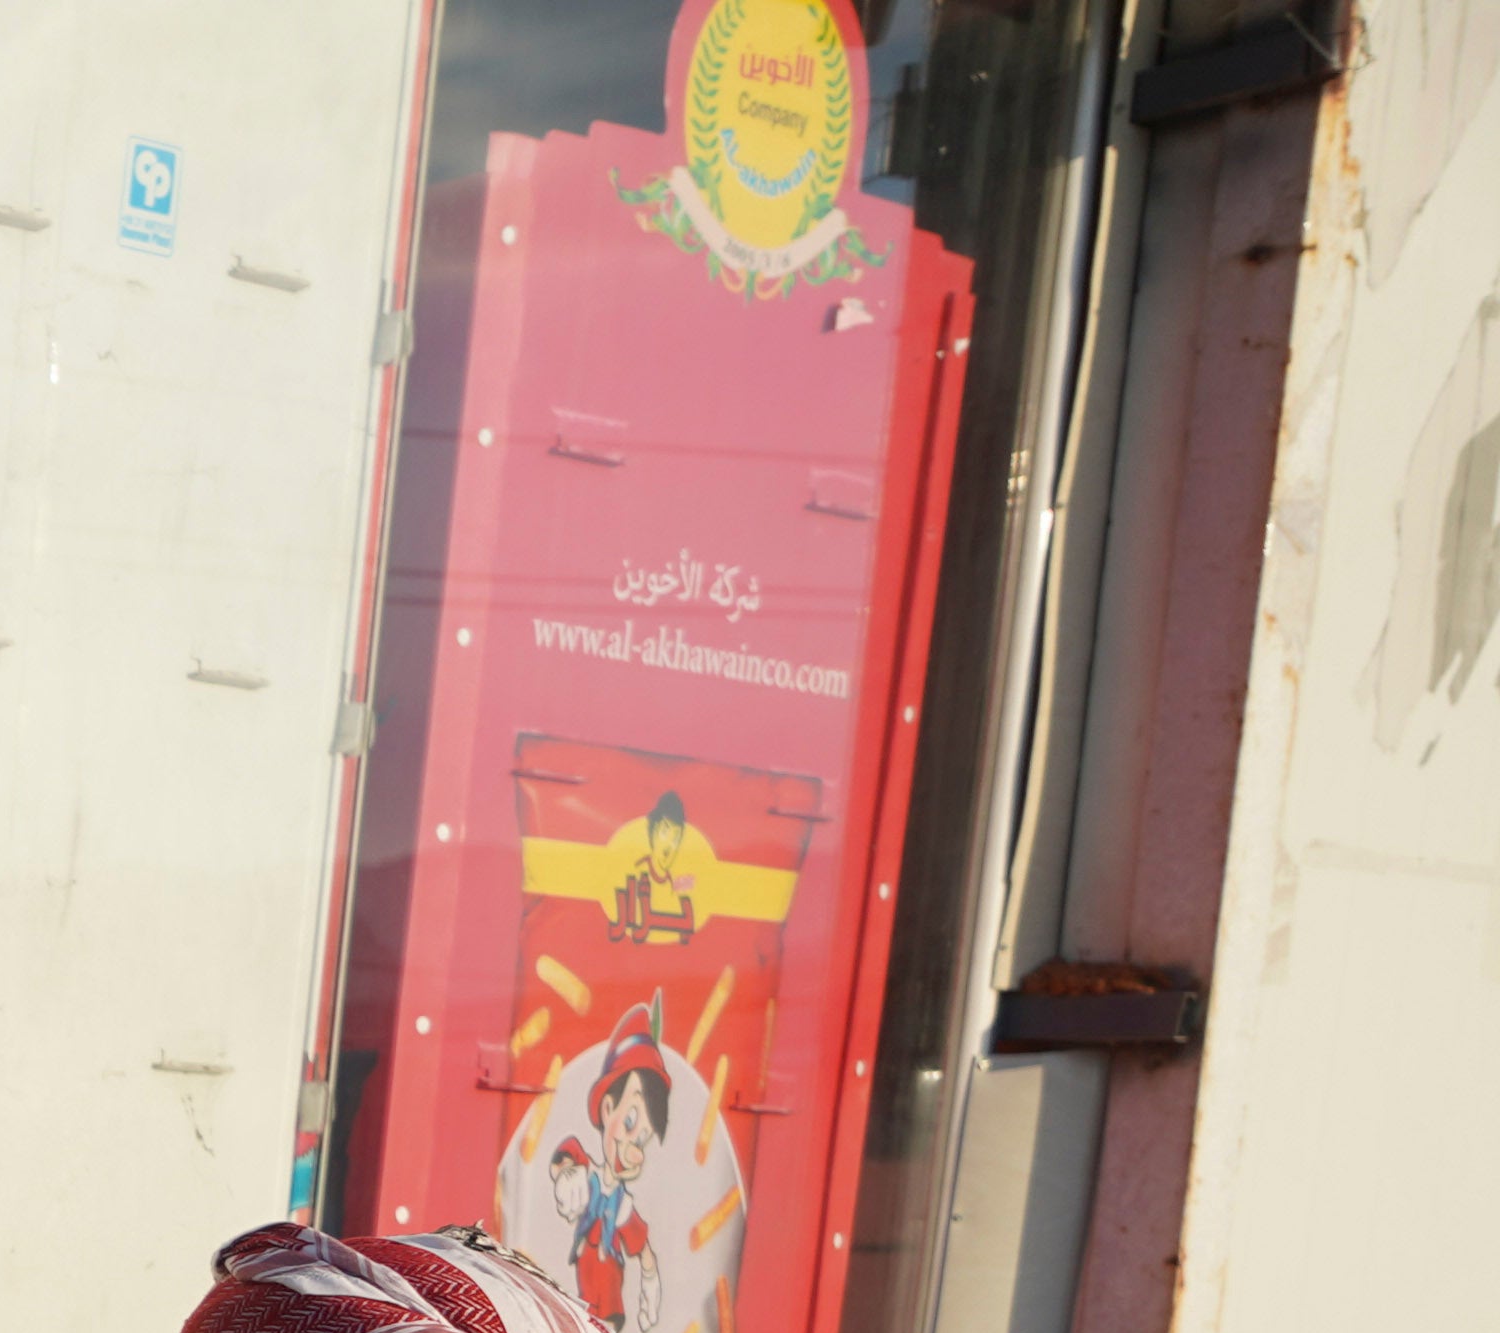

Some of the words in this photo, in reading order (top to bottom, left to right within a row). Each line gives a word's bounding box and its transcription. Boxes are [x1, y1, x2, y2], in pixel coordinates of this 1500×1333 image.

[737, 91, 809, 138] Company
[708, 562, 761, 623] شركة
[531, 616, 850, 699] www.al-akhawainco.com
